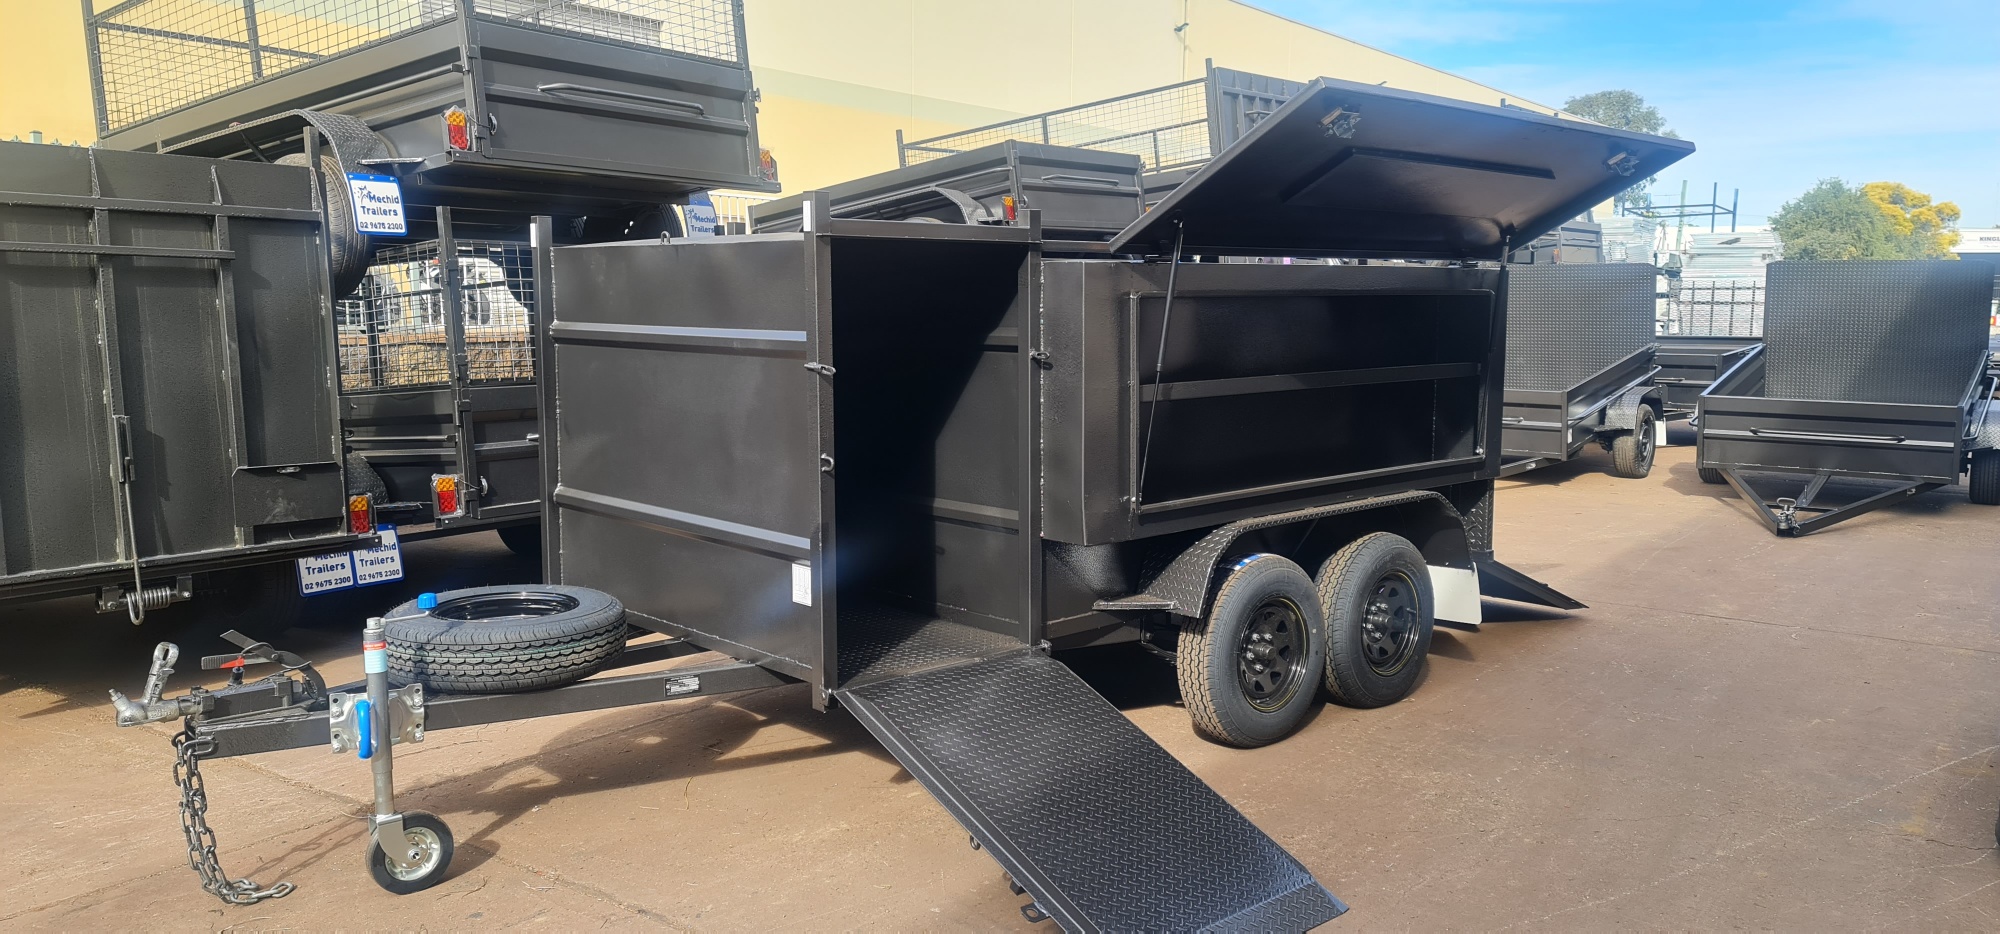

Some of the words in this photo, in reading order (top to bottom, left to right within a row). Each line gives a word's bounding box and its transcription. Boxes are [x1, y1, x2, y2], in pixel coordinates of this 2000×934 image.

[368, 194, 400, 204] Mechid
[360, 205, 398, 216] Trailers
[695, 215, 715, 223] Mechid
[360, 221, 369, 229] 02
[370, 222, 386, 230] 9675
[387, 222, 403, 230] 2300
[359, 556, 395, 567] Trailers
[306, 563, 346, 575] Trailers
[368, 571, 383, 580] 9675
[384, 569, 400, 577] 2300
[304, 582, 314, 590] 02
[315, 578, 333, 588] 9675
[334, 576, 351, 585] 2300
